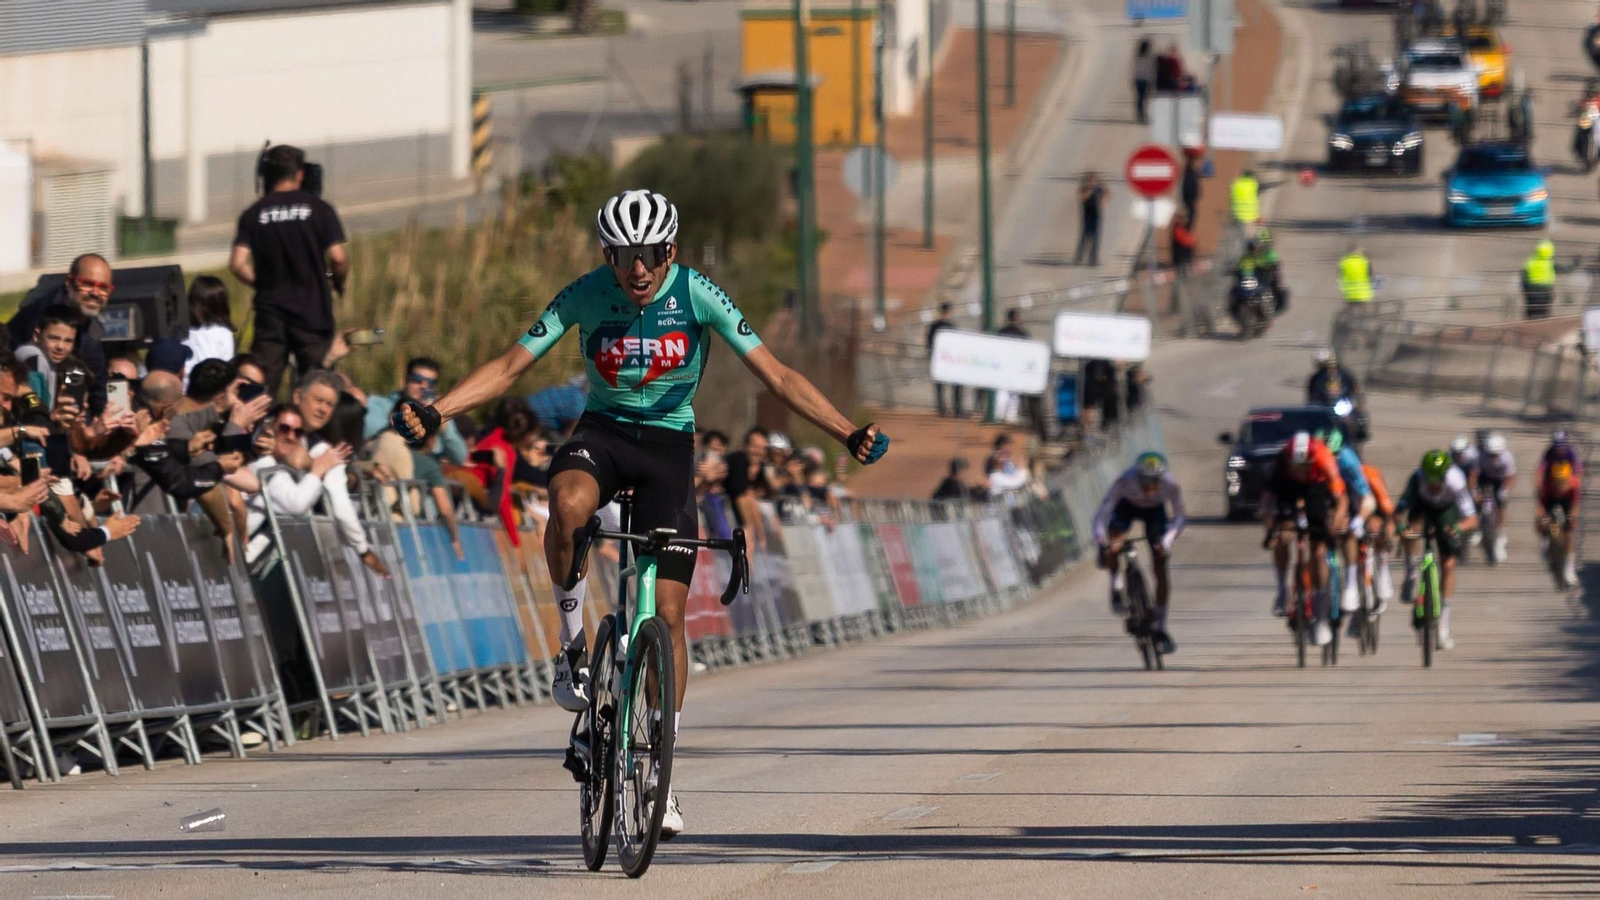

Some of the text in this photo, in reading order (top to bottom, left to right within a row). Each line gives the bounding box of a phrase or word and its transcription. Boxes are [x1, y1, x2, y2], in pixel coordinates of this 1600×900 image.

[259, 205, 312, 224] STAFF
[693, 275, 732, 314] PHARMA
[601, 337, 686, 358] KERN
[601, 356, 686, 367] PHARMA
[662, 545, 694, 555] IANT
